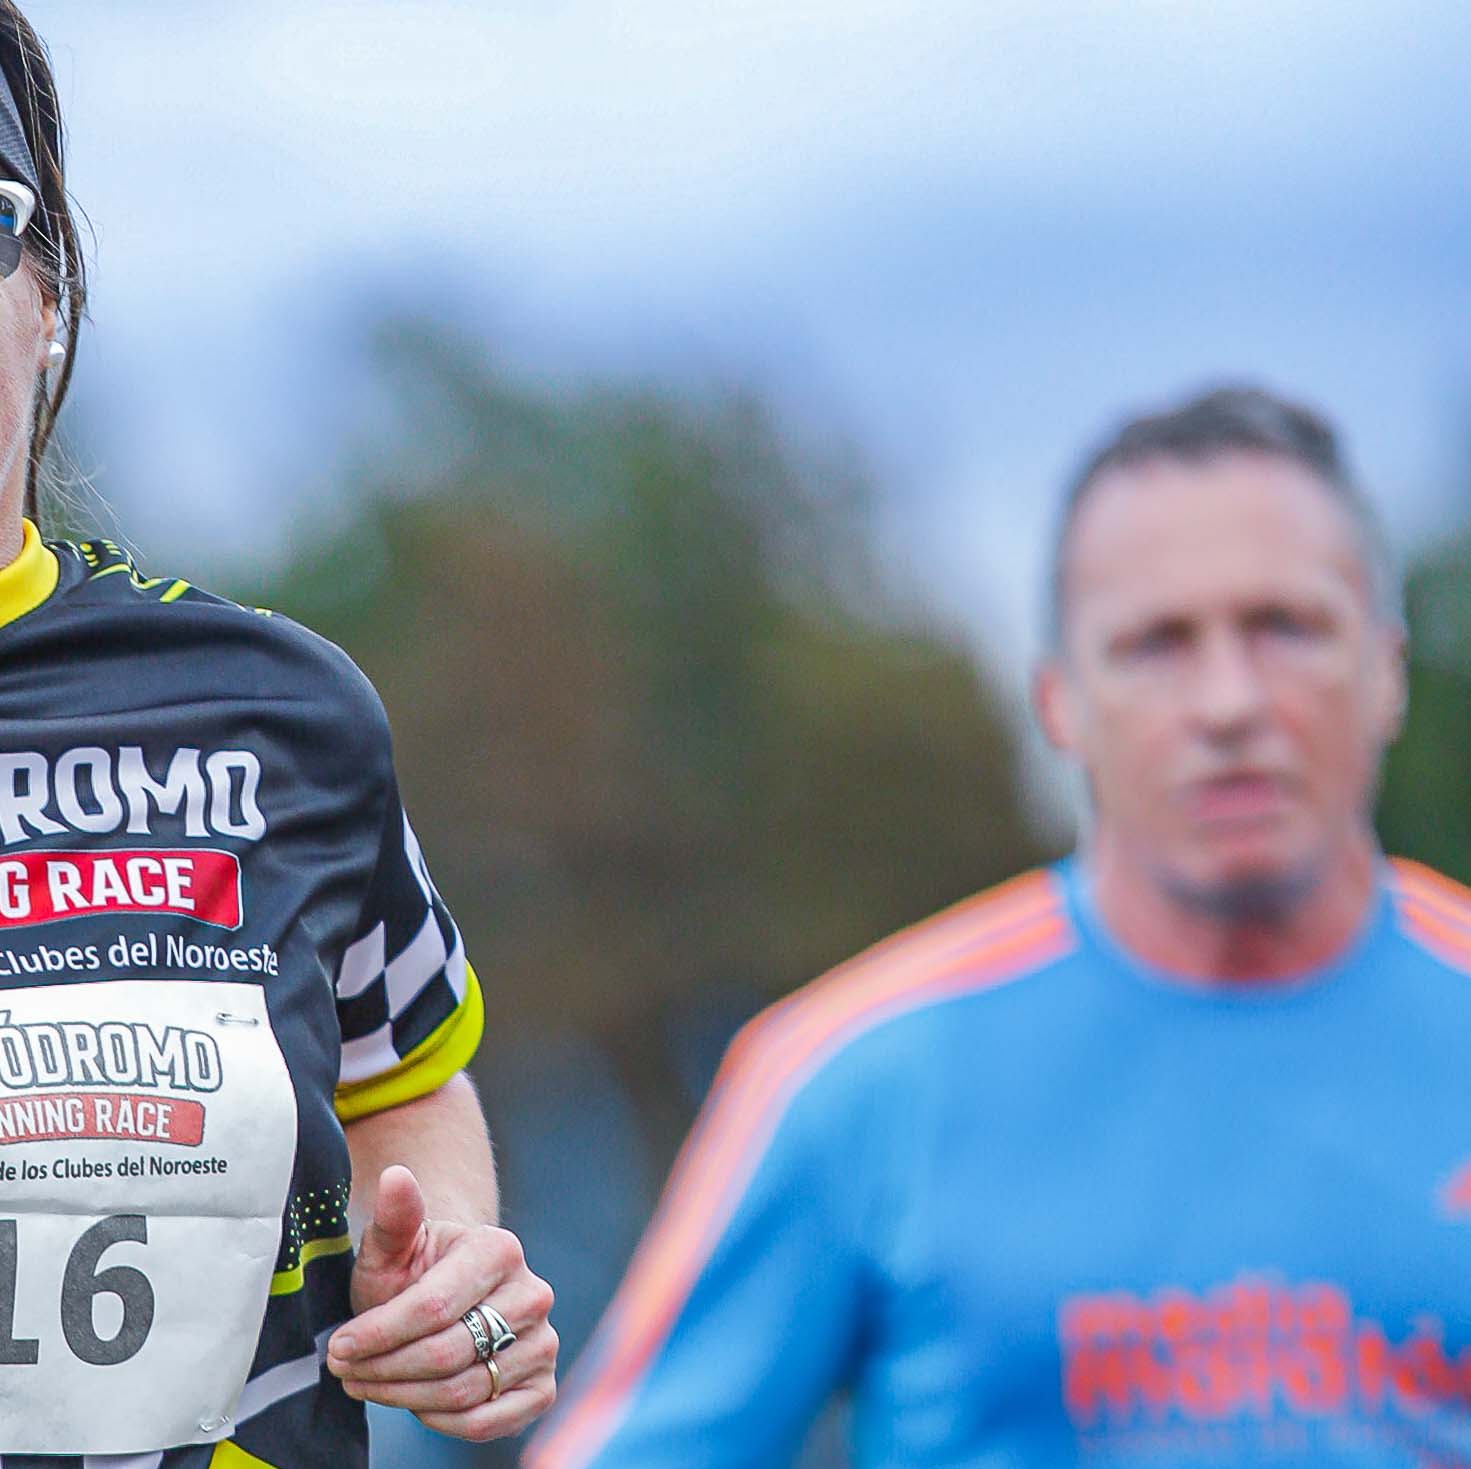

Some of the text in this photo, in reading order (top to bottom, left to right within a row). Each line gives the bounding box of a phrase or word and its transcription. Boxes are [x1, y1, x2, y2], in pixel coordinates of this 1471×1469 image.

[46, 857, 196, 913] RACE
[108, 933, 157, 967] del
[166, 934, 279, 976] Noroeste
[95, 1098, 172, 1138] RACE
[22, 1160, 47, 1180] los
[52, 1158, 113, 1179] Clubes
[117, 1156, 145, 1178] del
[150, 1156, 228, 1176] Noroeste
